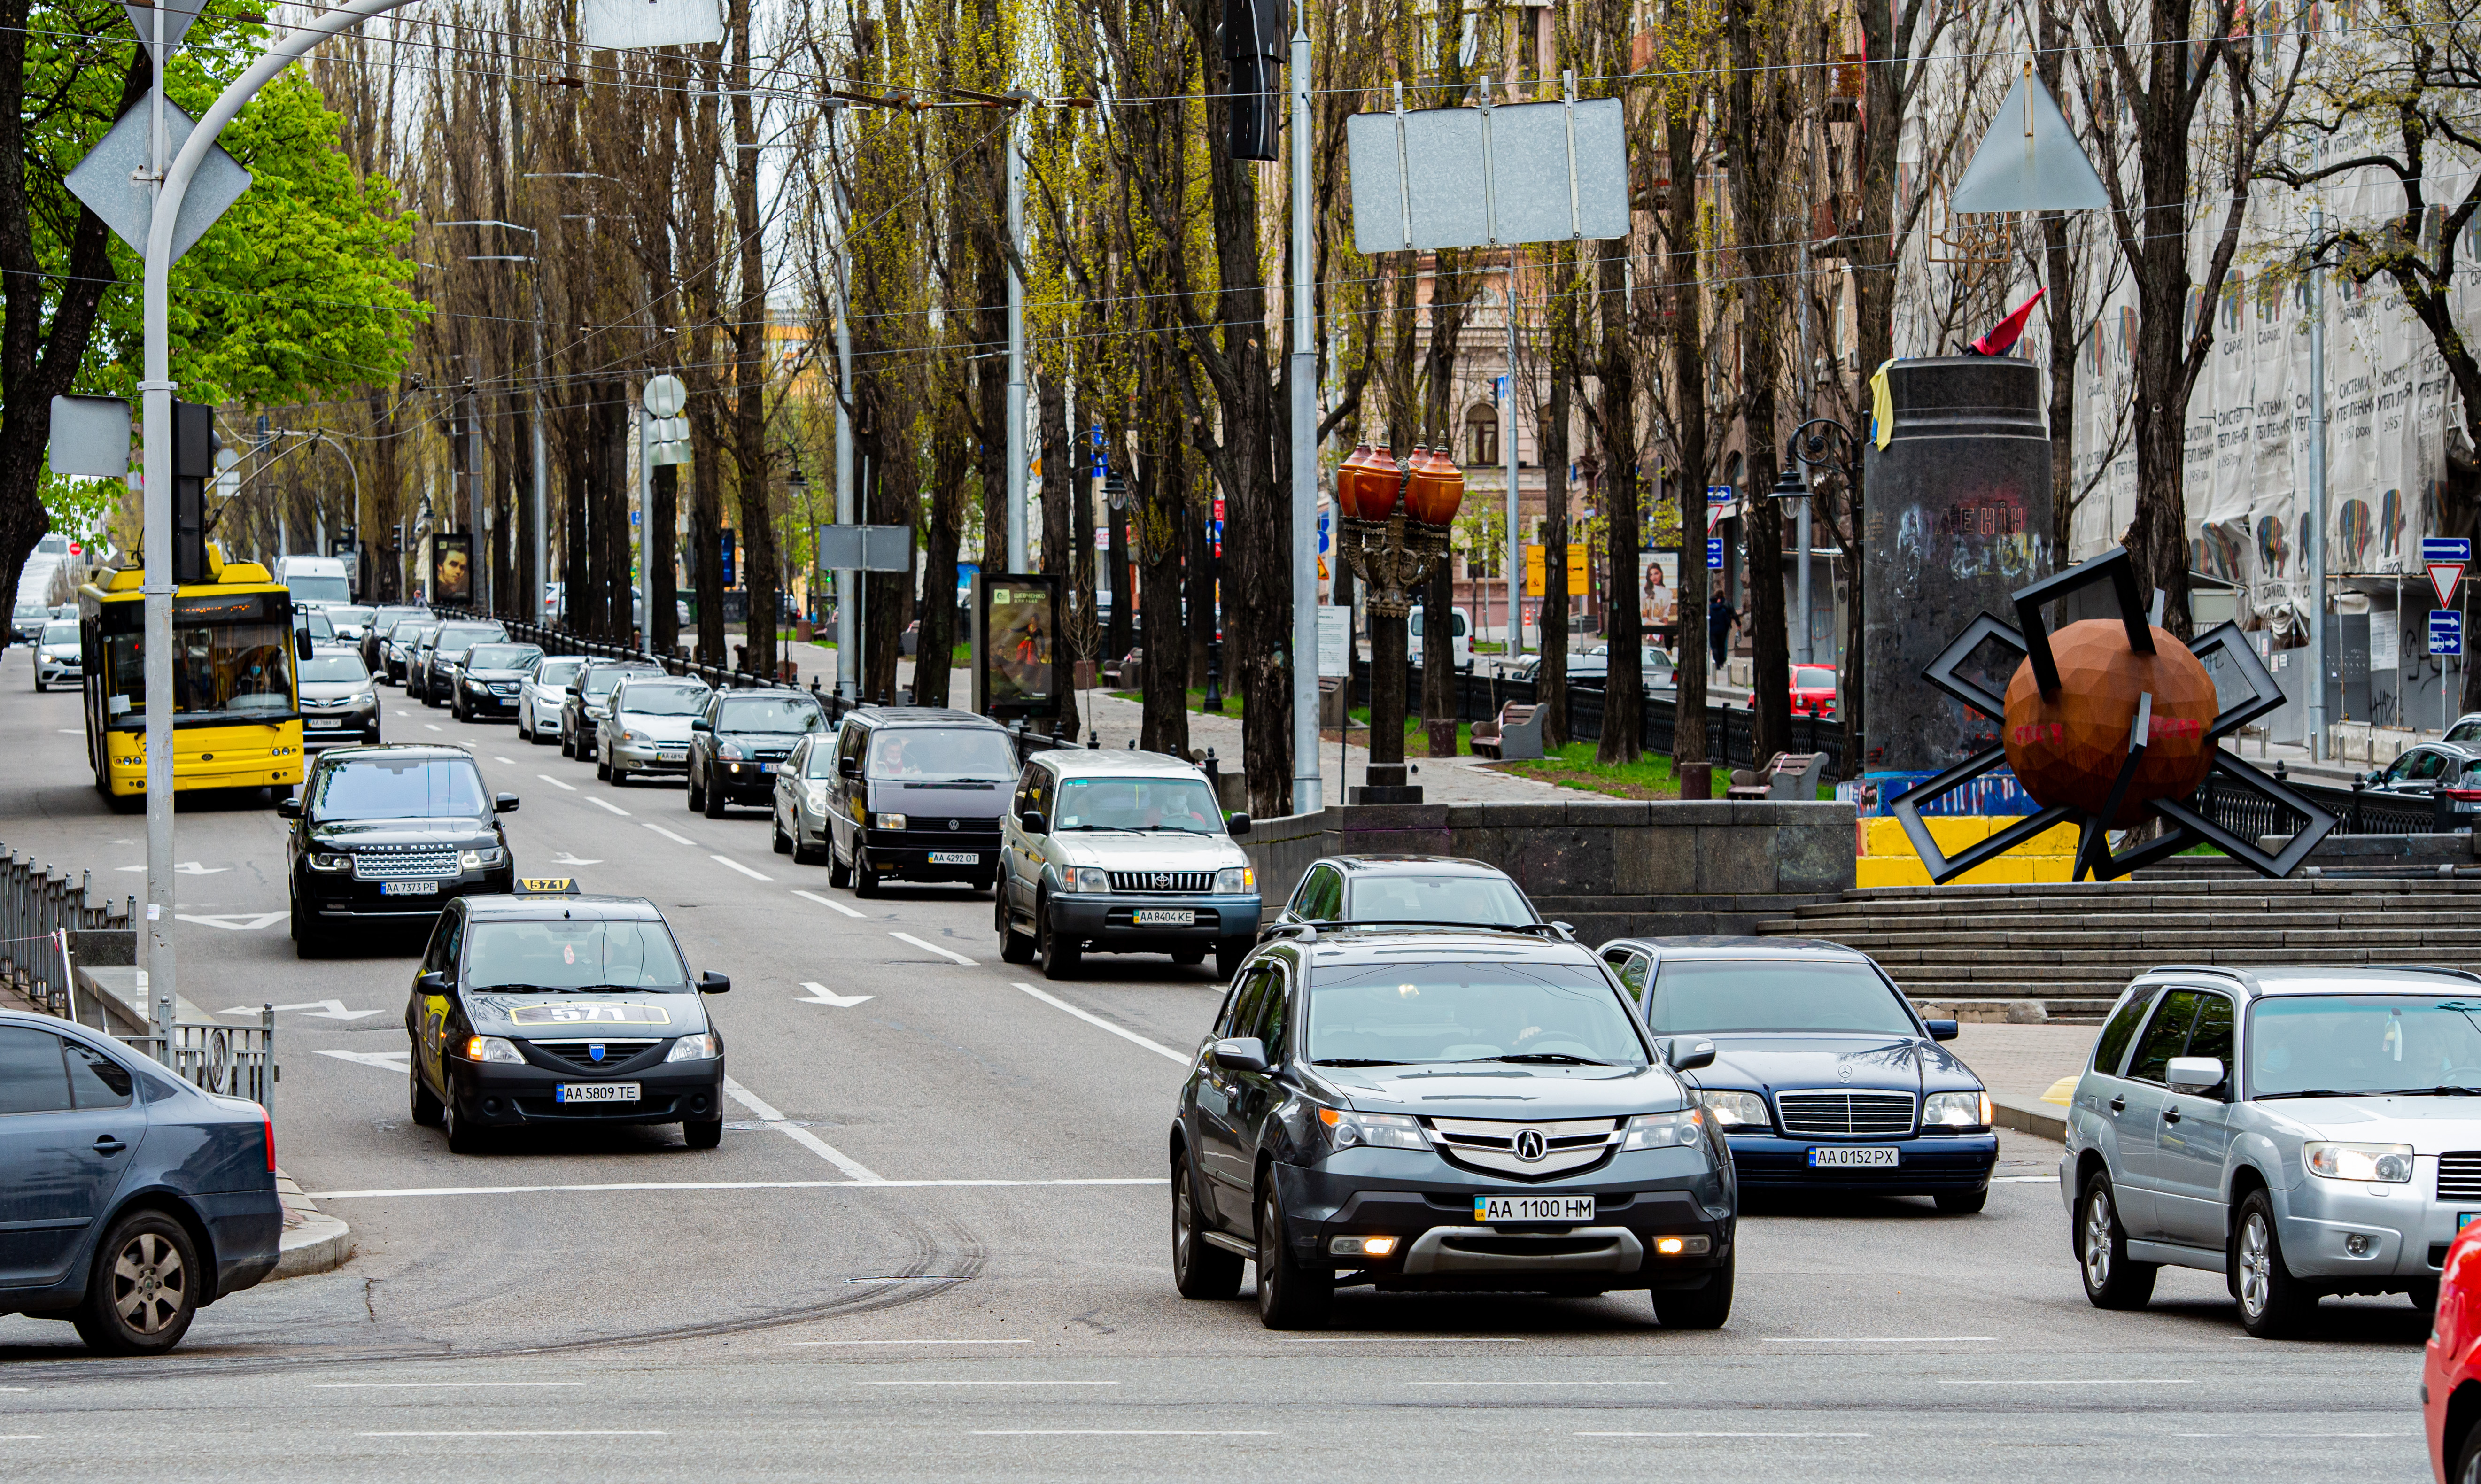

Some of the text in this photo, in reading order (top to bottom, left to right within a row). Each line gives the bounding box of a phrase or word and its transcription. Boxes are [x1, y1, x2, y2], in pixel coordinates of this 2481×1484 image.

[387, 883, 436, 892] AA 7373 PE
[532, 880, 560, 889] 571
[1140, 912, 1153, 921] AA
[1155, 912, 1176, 921] 8404
[1178, 912, 1192, 921] KE
[550, 1006, 626, 1021] 571
[566, 1088, 582, 1100] AA
[586, 1087, 615, 1099] 5809
[618, 1086, 636, 1098] TE
[1818, 1150, 1837, 1164] AA
[1840, 1150, 1871, 1164] 0152
[1875, 1150, 1893, 1164] PX
[1487, 1200, 1512, 1218] AA
[1520, 1200, 1560, 1217] 1100
[1566, 1200, 1592, 1217] HM
